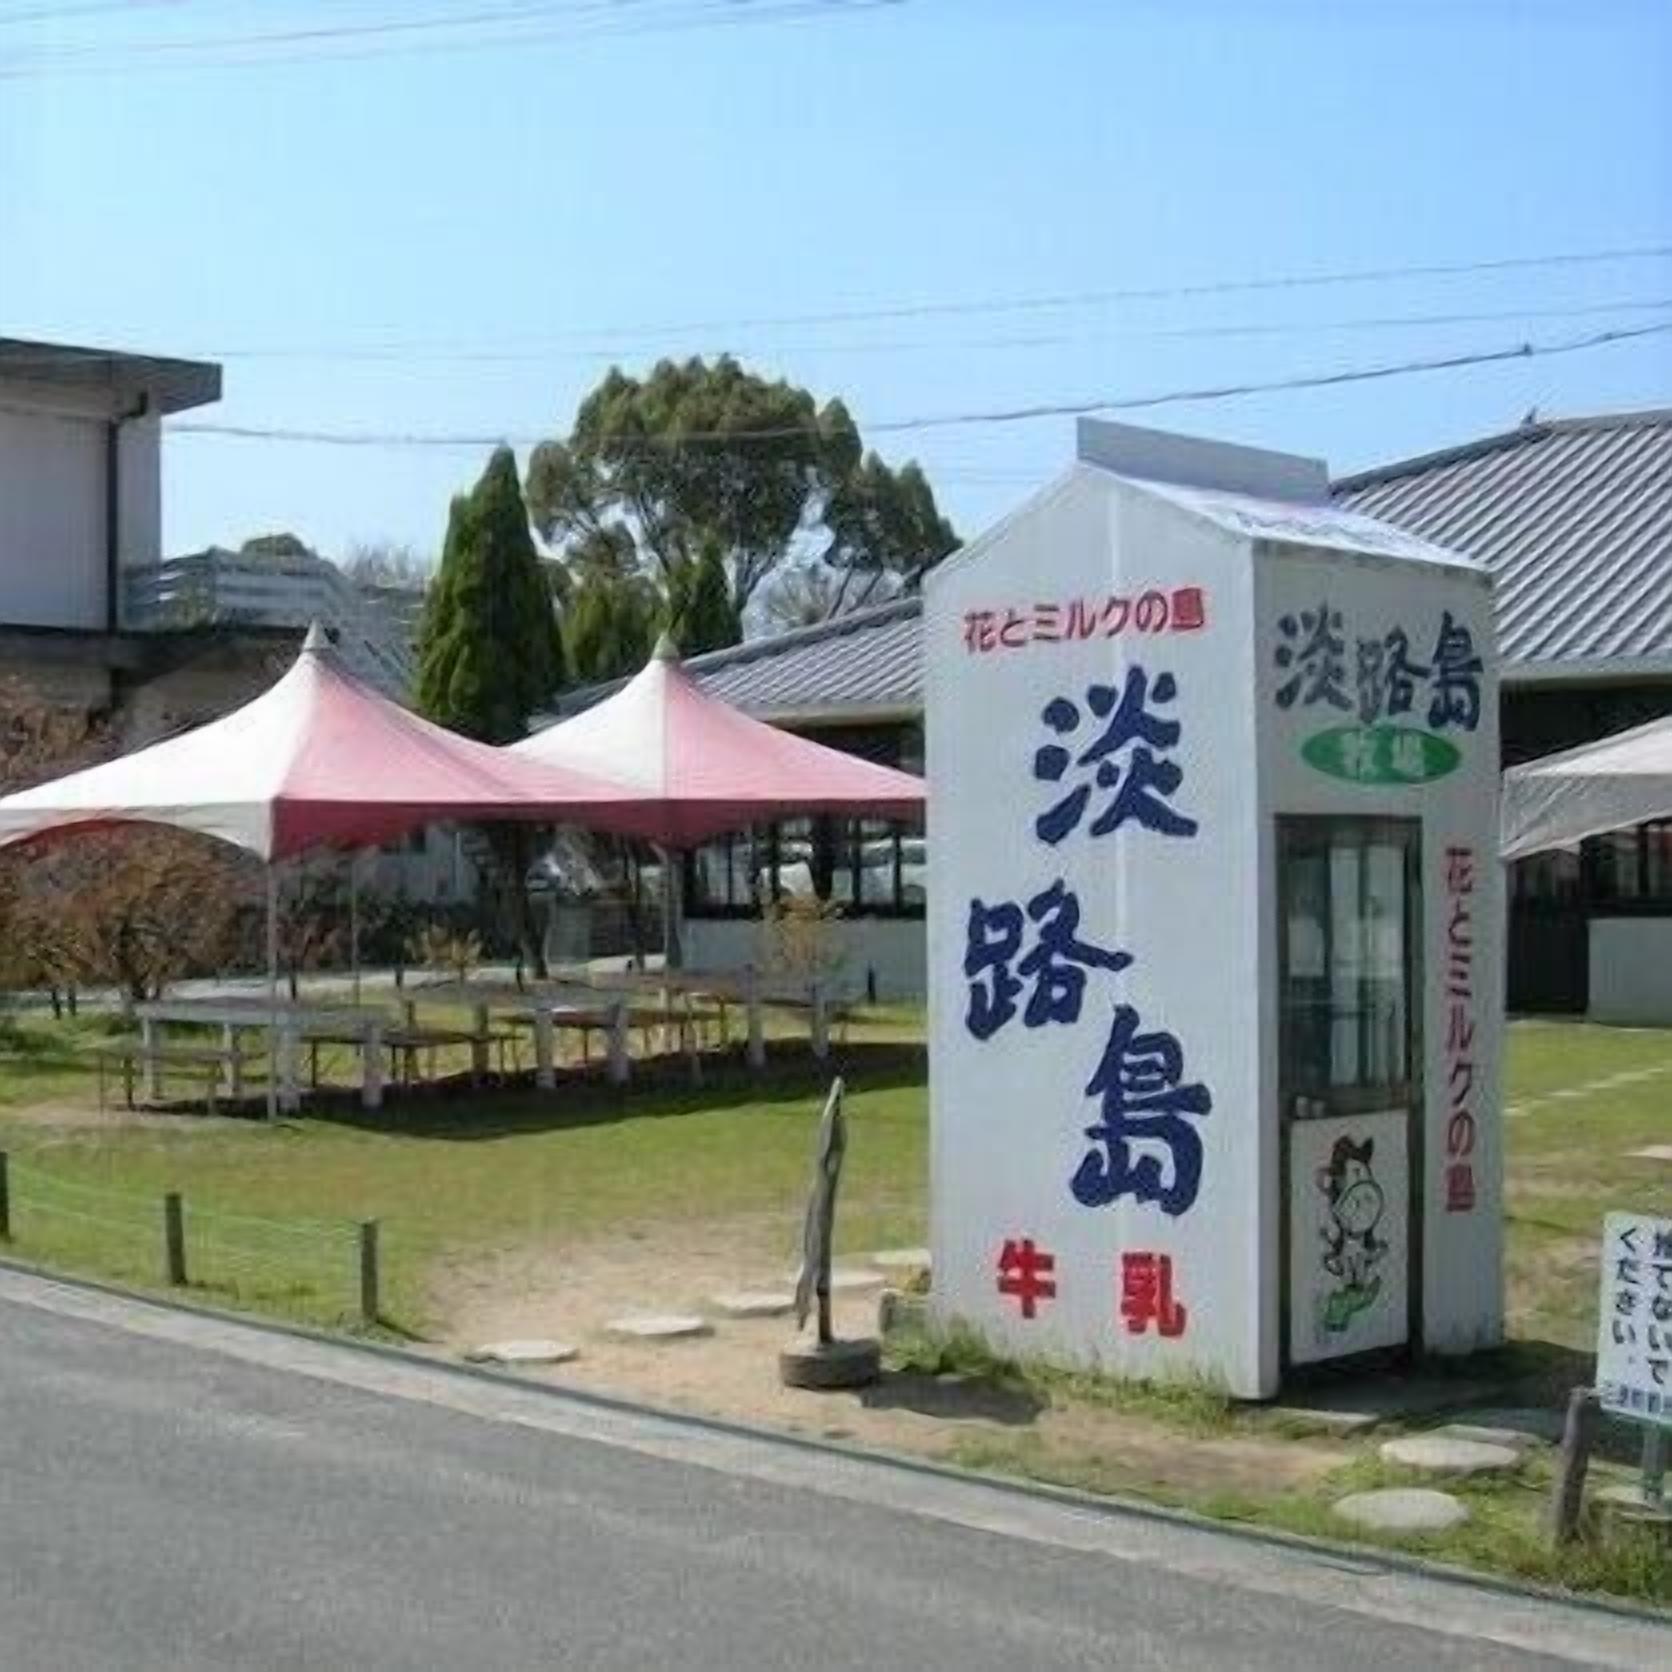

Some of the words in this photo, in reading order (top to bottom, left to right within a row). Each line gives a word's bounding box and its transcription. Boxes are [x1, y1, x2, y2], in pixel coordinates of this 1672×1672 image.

[964, 588, 1204, 652] 花とミルクの
[1275, 601, 1484, 731] 淡路島
[964, 665, 1212, 1216] 淡路島
[1446, 848, 1476, 1212] 花とミルクの
[997, 1238, 1187, 1338] 牛乳
